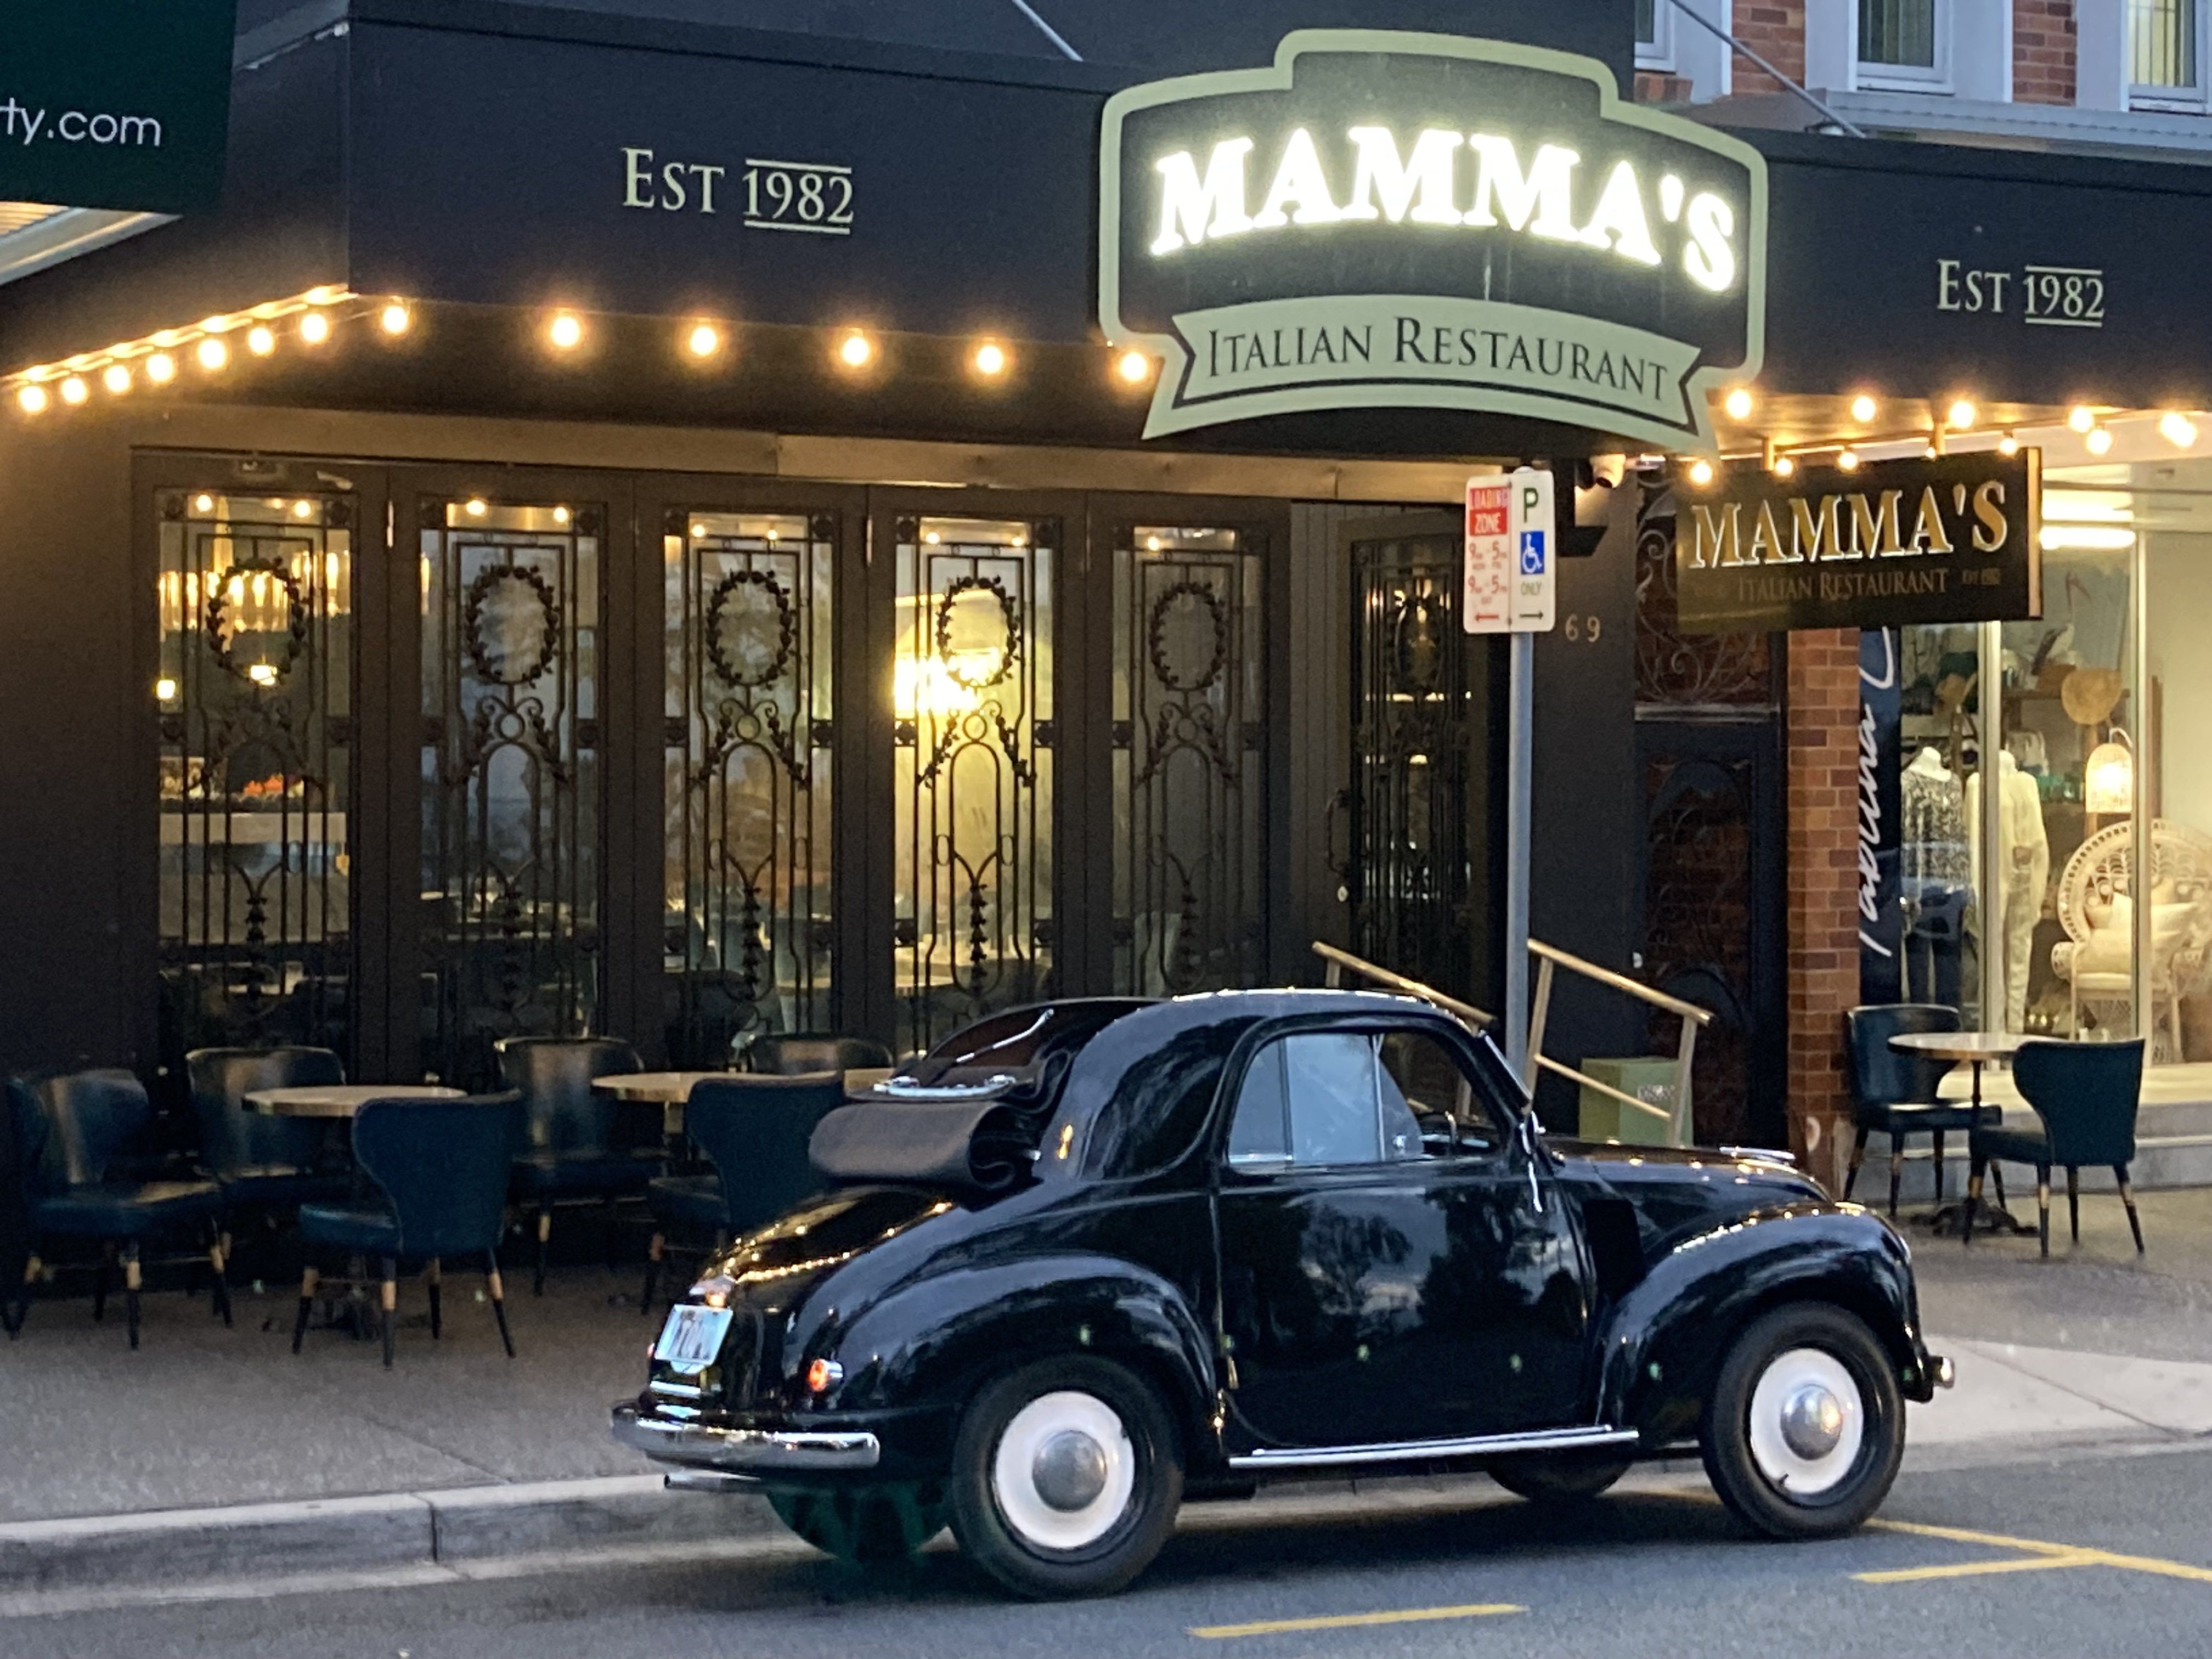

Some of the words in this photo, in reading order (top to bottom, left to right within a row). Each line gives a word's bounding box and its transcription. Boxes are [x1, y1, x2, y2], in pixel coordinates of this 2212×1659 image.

[0, 97, 161, 146] ty.com
[620, 146, 725, 213] EST
[742, 167, 854, 224] 1982
[1150, 125, 1736, 293] MAMMA'S
[1936, 258, 2011, 313] EST
[2023, 274, 2104, 318] 1982
[1208, 324, 1373, 377] ITALIAN
[1393, 316, 1668, 401] RESTAURANT
[1474, 512, 1502, 534] ZONE
[1523, 487, 1539, 523] P
[1688, 479, 2008, 569] MAMMA'S
[1521, 582, 1542, 596] ONLY
[1738, 576, 1812, 602] ITALIAN
[1819, 567, 1949, 600] RESTAURANT
